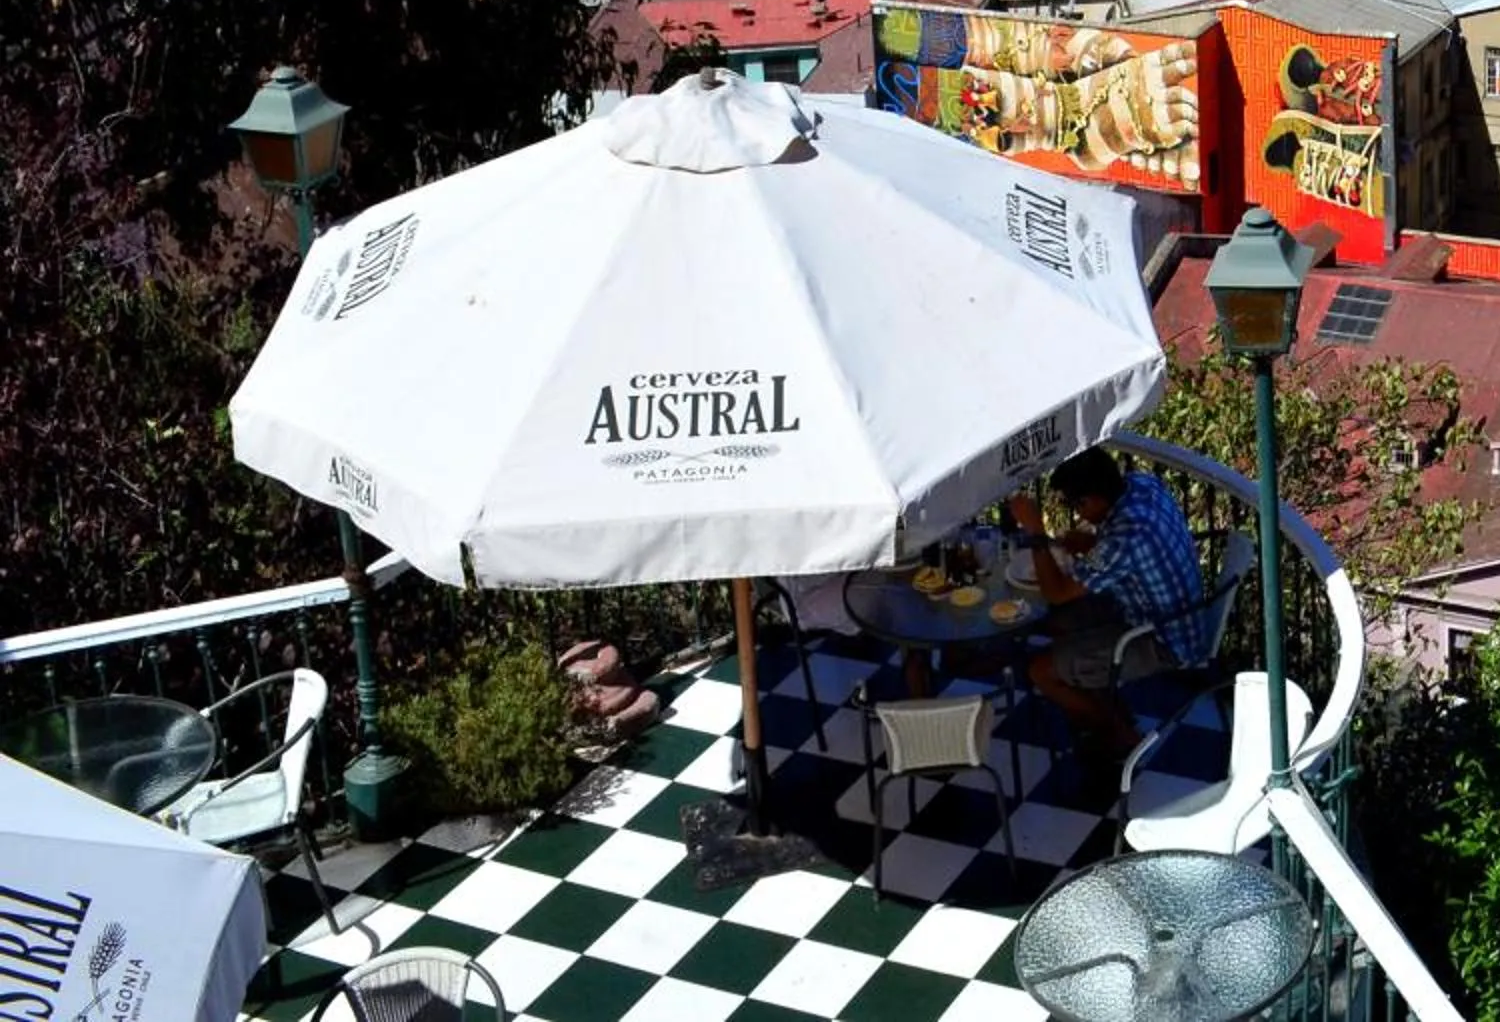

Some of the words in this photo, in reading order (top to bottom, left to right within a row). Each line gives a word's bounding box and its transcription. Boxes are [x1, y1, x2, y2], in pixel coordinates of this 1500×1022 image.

[1014, 183, 1075, 280] AUSTRAL
[334, 212, 417, 321] AUSTRAL
[584, 375, 800, 444] AUSTRAL
[629, 369, 759, 389] cerveza
[632, 464, 748, 480] PATAGONIA
